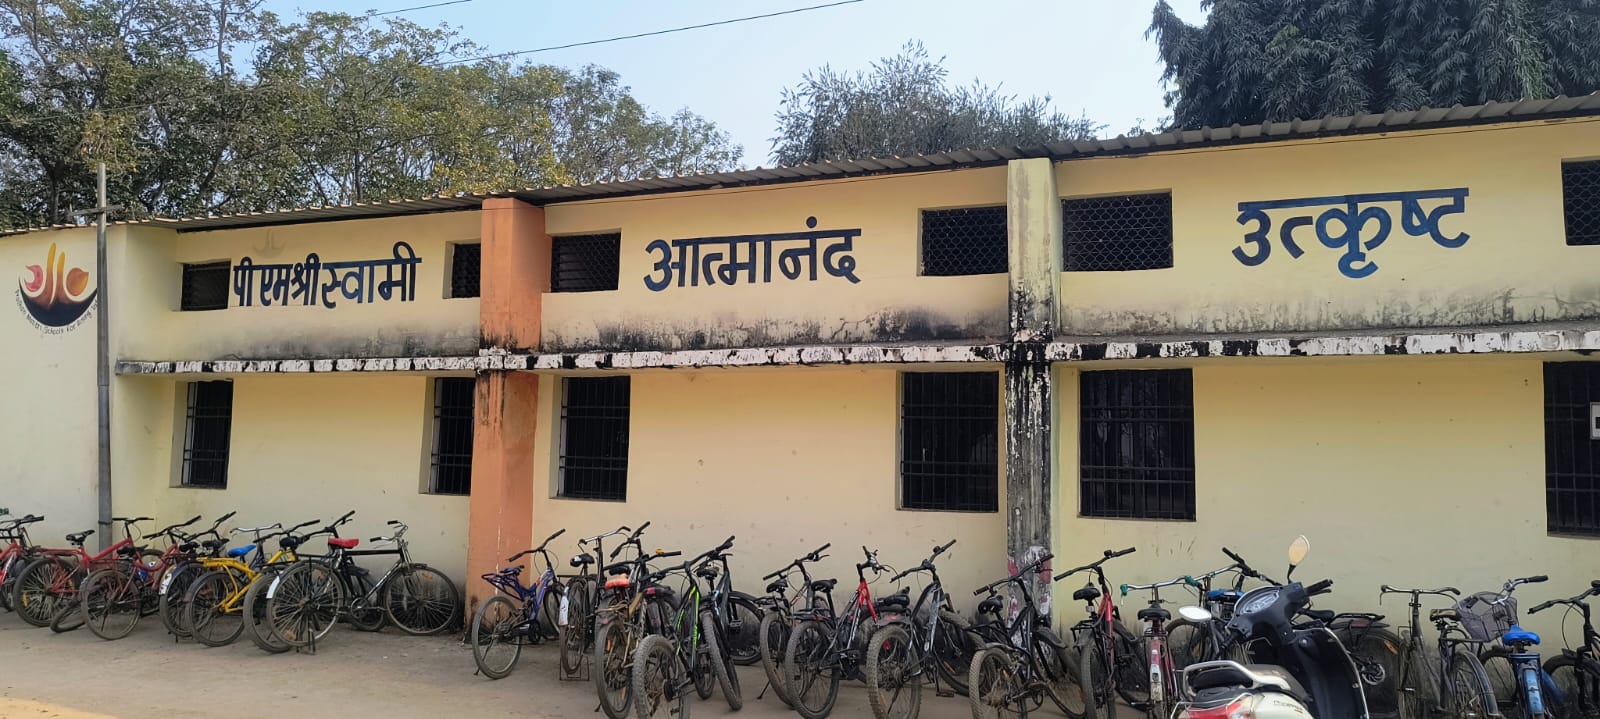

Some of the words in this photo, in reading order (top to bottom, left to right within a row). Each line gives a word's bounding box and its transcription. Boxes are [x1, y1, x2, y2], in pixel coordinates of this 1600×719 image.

[643, 216, 862, 292] आत्मानंद
[1232, 187, 1470, 278] उत्कृष्ट
[321, 241, 422, 309] स्वामी
